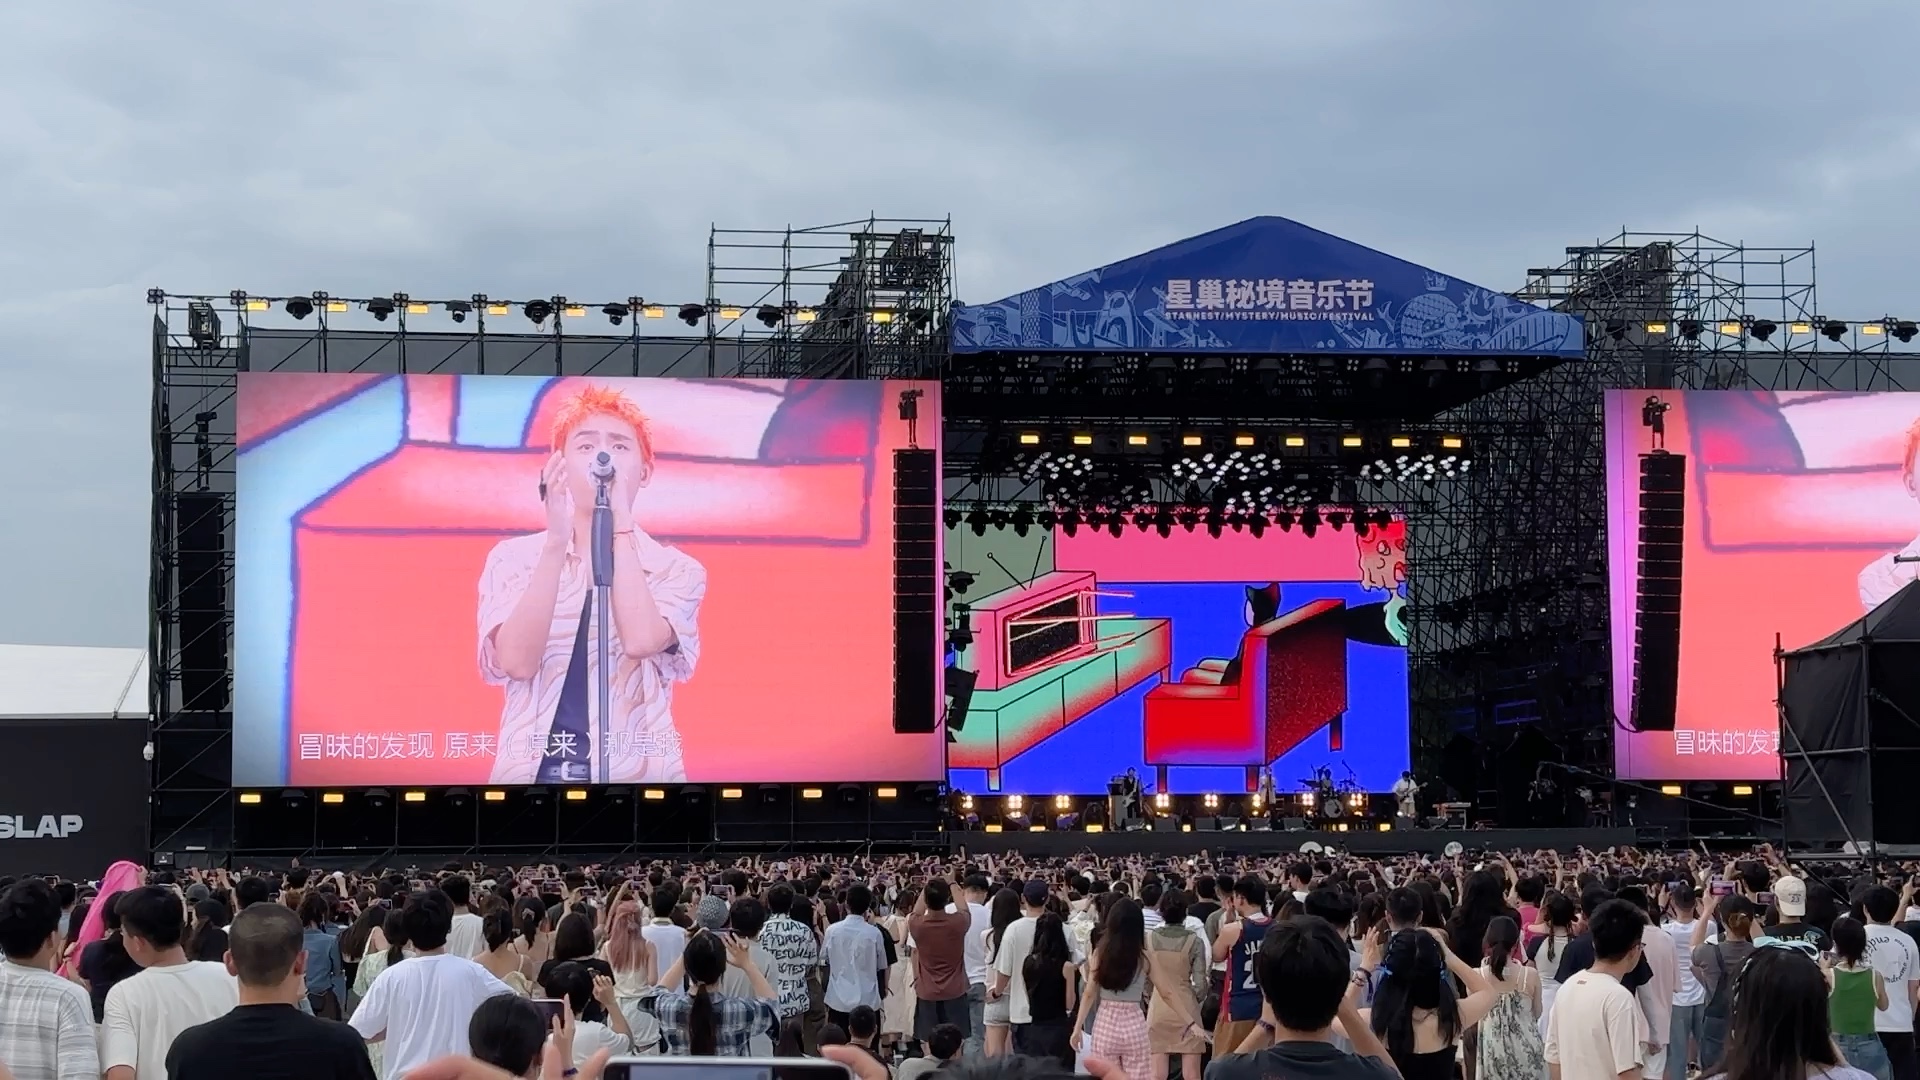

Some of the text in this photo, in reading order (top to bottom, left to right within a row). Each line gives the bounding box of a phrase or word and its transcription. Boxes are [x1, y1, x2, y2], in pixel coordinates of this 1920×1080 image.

[1165, 279, 1375, 310] 星巢秘境音乐节
[299, 731, 435, 761] 冒昧的发现
[0, 814, 84, 839] SLAP
